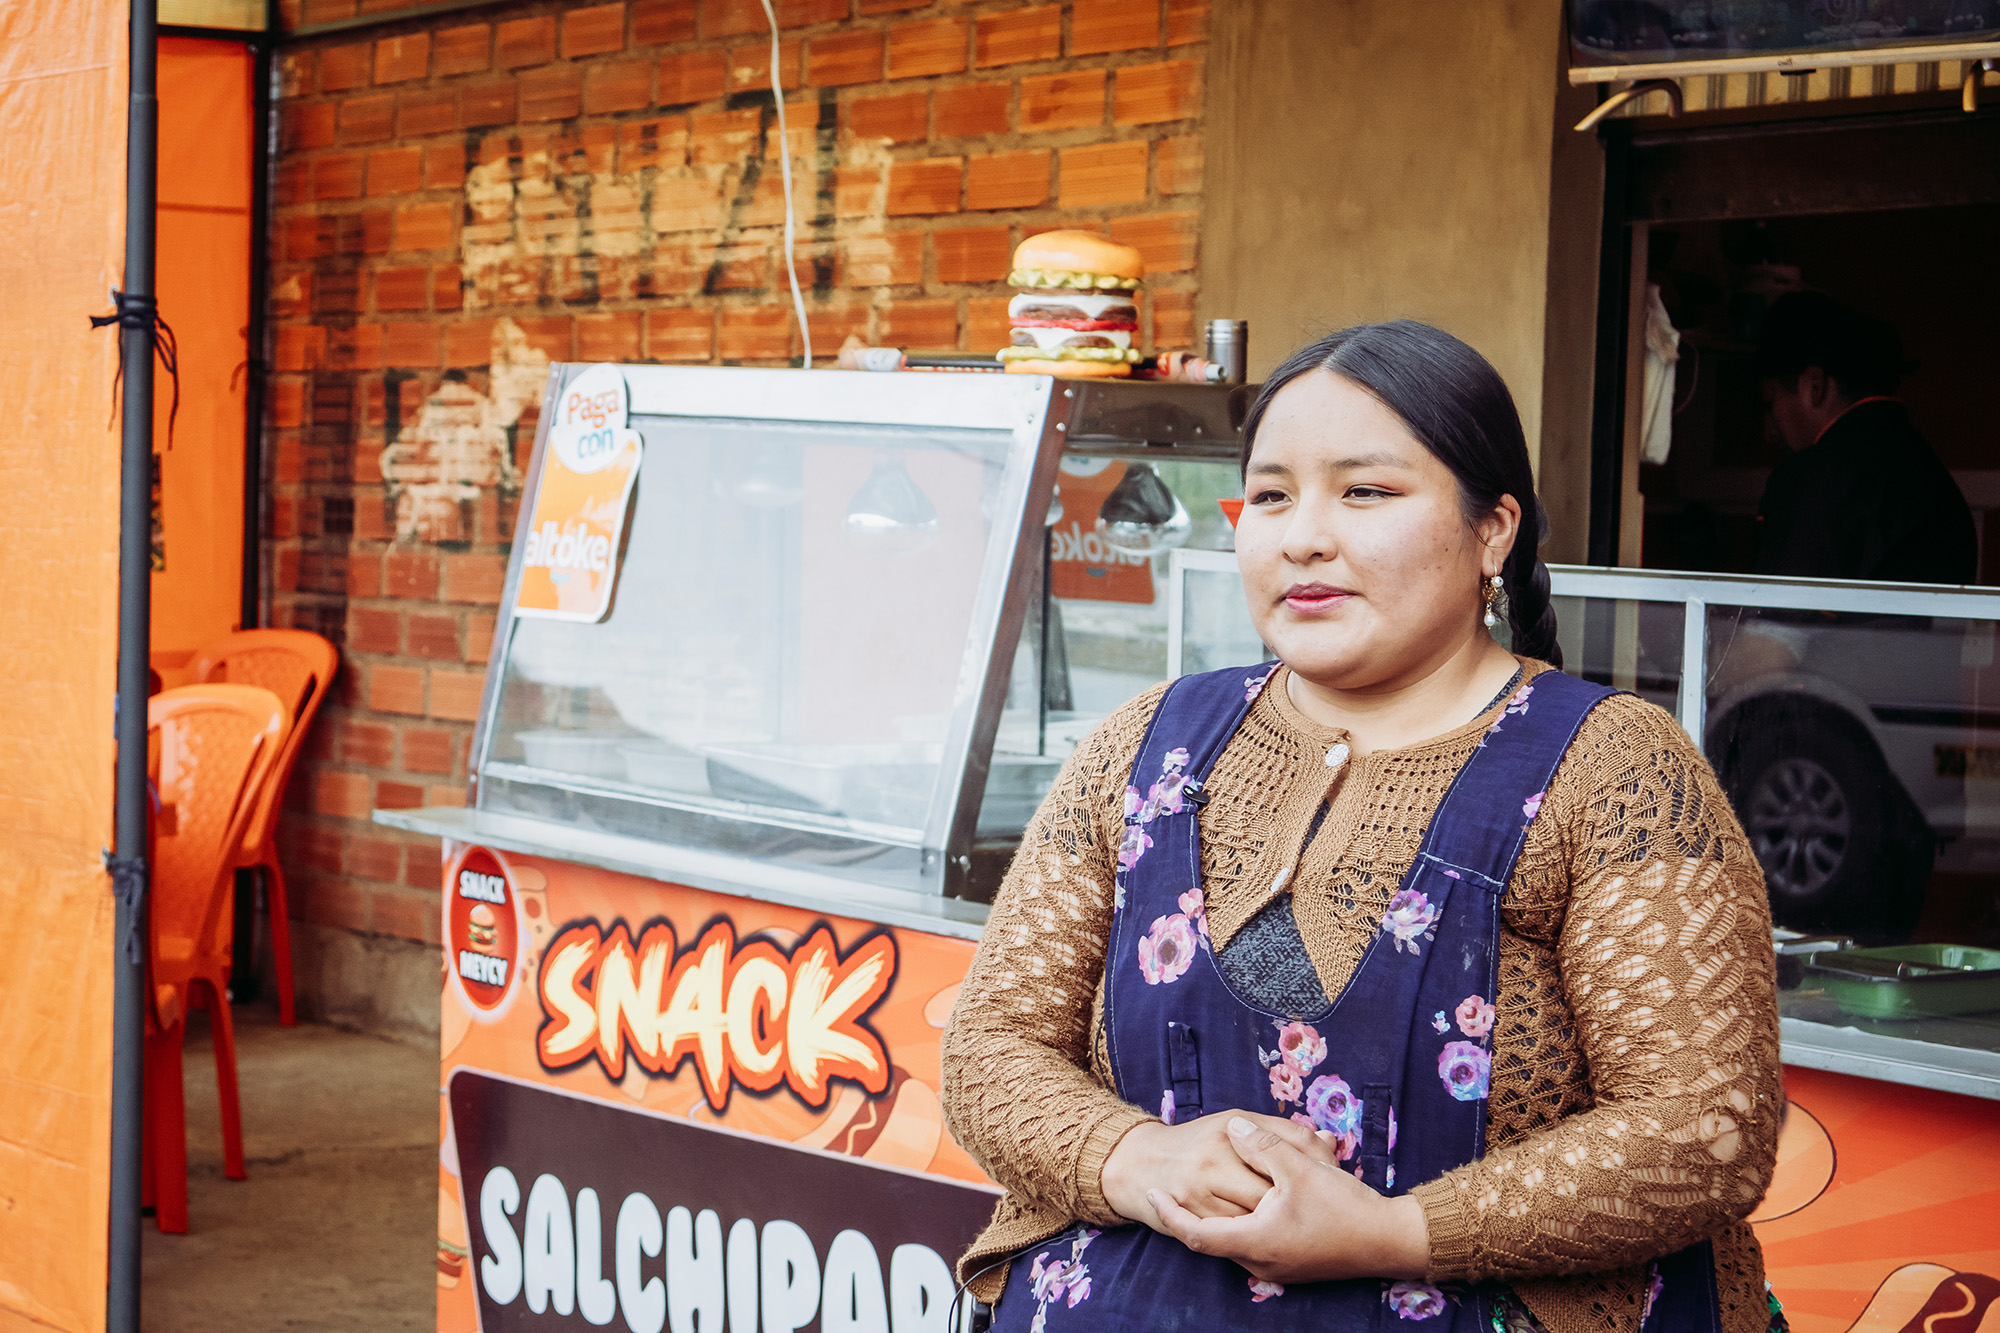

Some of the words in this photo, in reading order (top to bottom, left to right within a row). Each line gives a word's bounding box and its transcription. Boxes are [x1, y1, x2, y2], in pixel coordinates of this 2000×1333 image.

[567, 390, 619, 428] Paga
[578, 428, 614, 459] con
[524, 520, 610, 571] altoke
[459, 869, 506, 905] SNACK
[540, 930, 890, 1106] SNACK
[480, 1166, 972, 1333] SALCHIPAP
